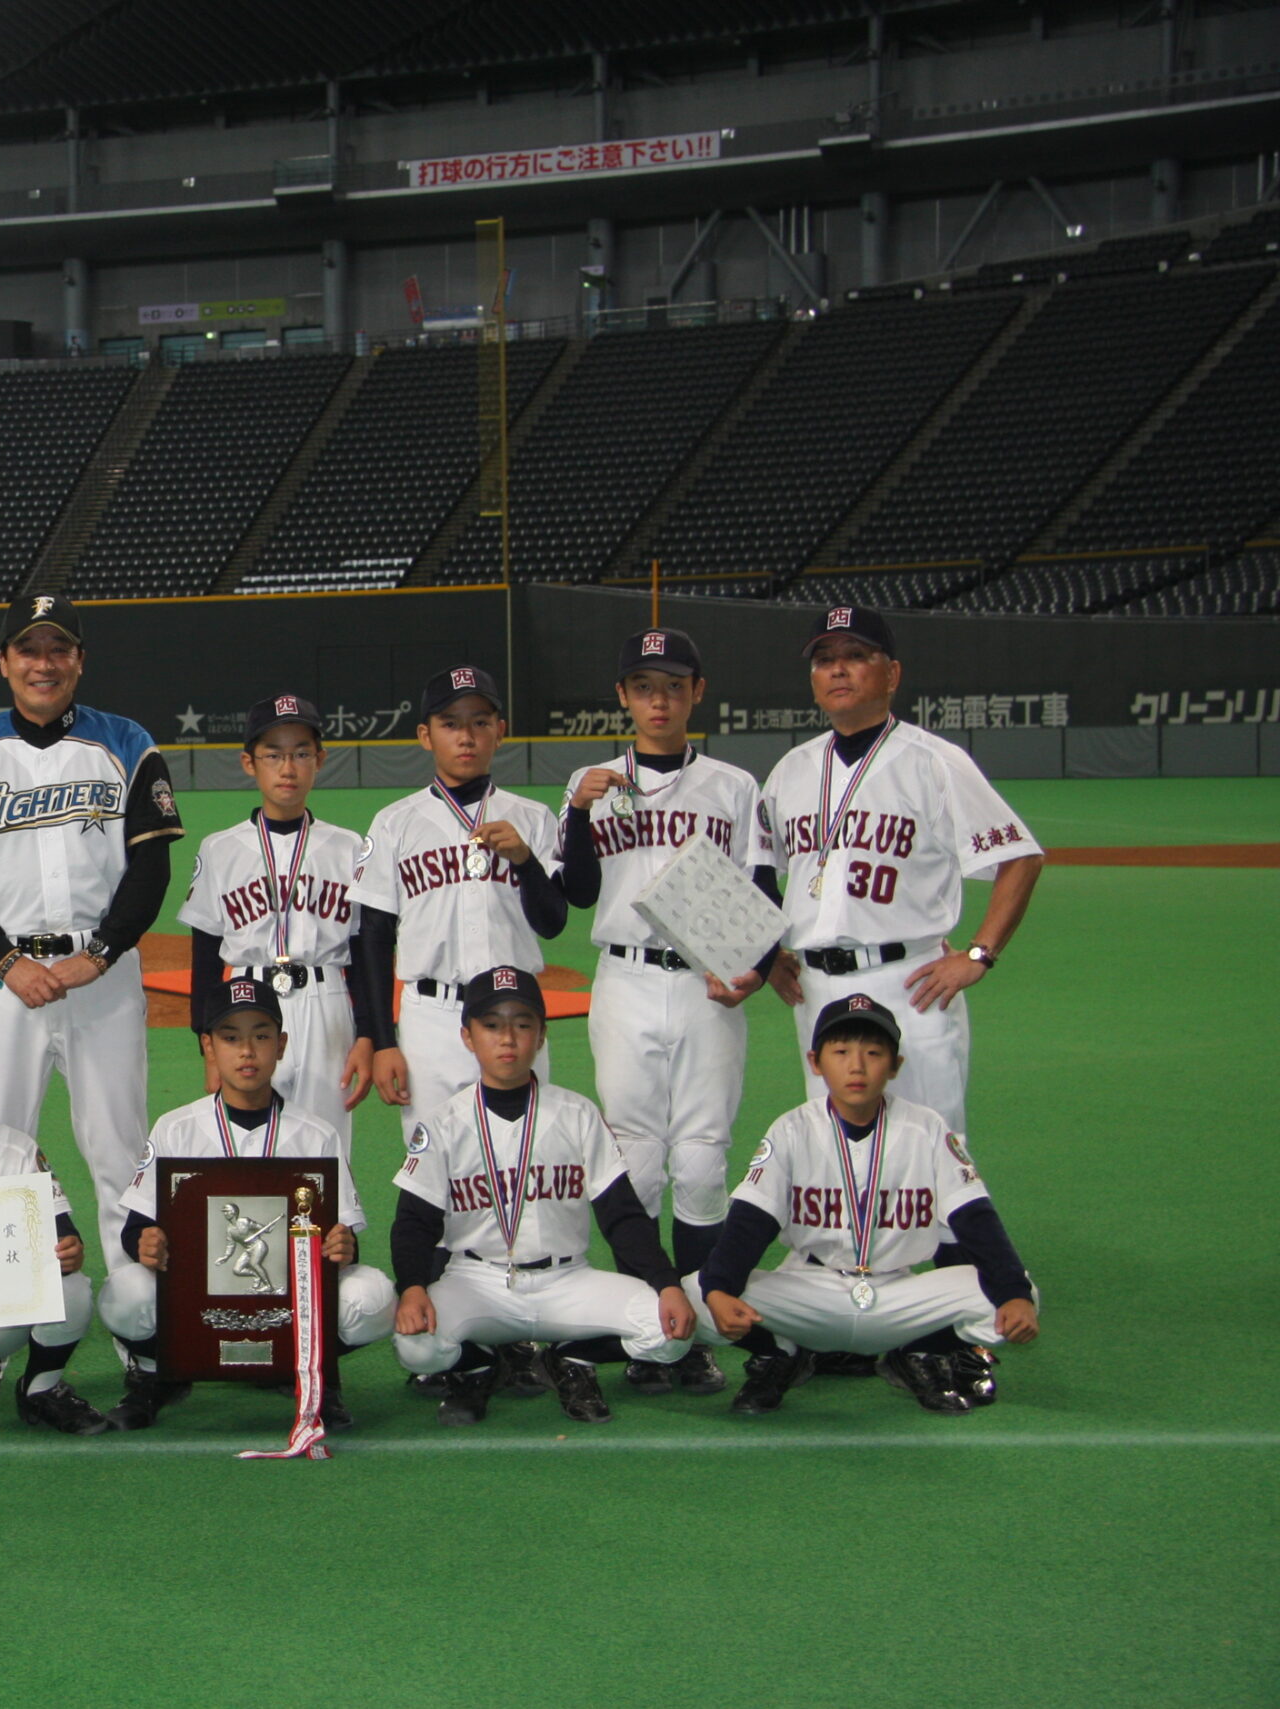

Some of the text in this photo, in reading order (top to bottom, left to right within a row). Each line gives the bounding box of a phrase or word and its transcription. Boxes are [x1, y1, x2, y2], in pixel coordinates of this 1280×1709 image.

[418, 136, 712, 186] 打球の行方にご注意下さい!!
[31, 596, 55, 619] F
[319, 700, 411, 739] ホップ
[912, 692, 1068, 729] 北海電気工事
[1131, 689, 1280, 726] クリーンリ
[971, 823, 1023, 854] 北海道
[847, 861, 898, 905] 30
